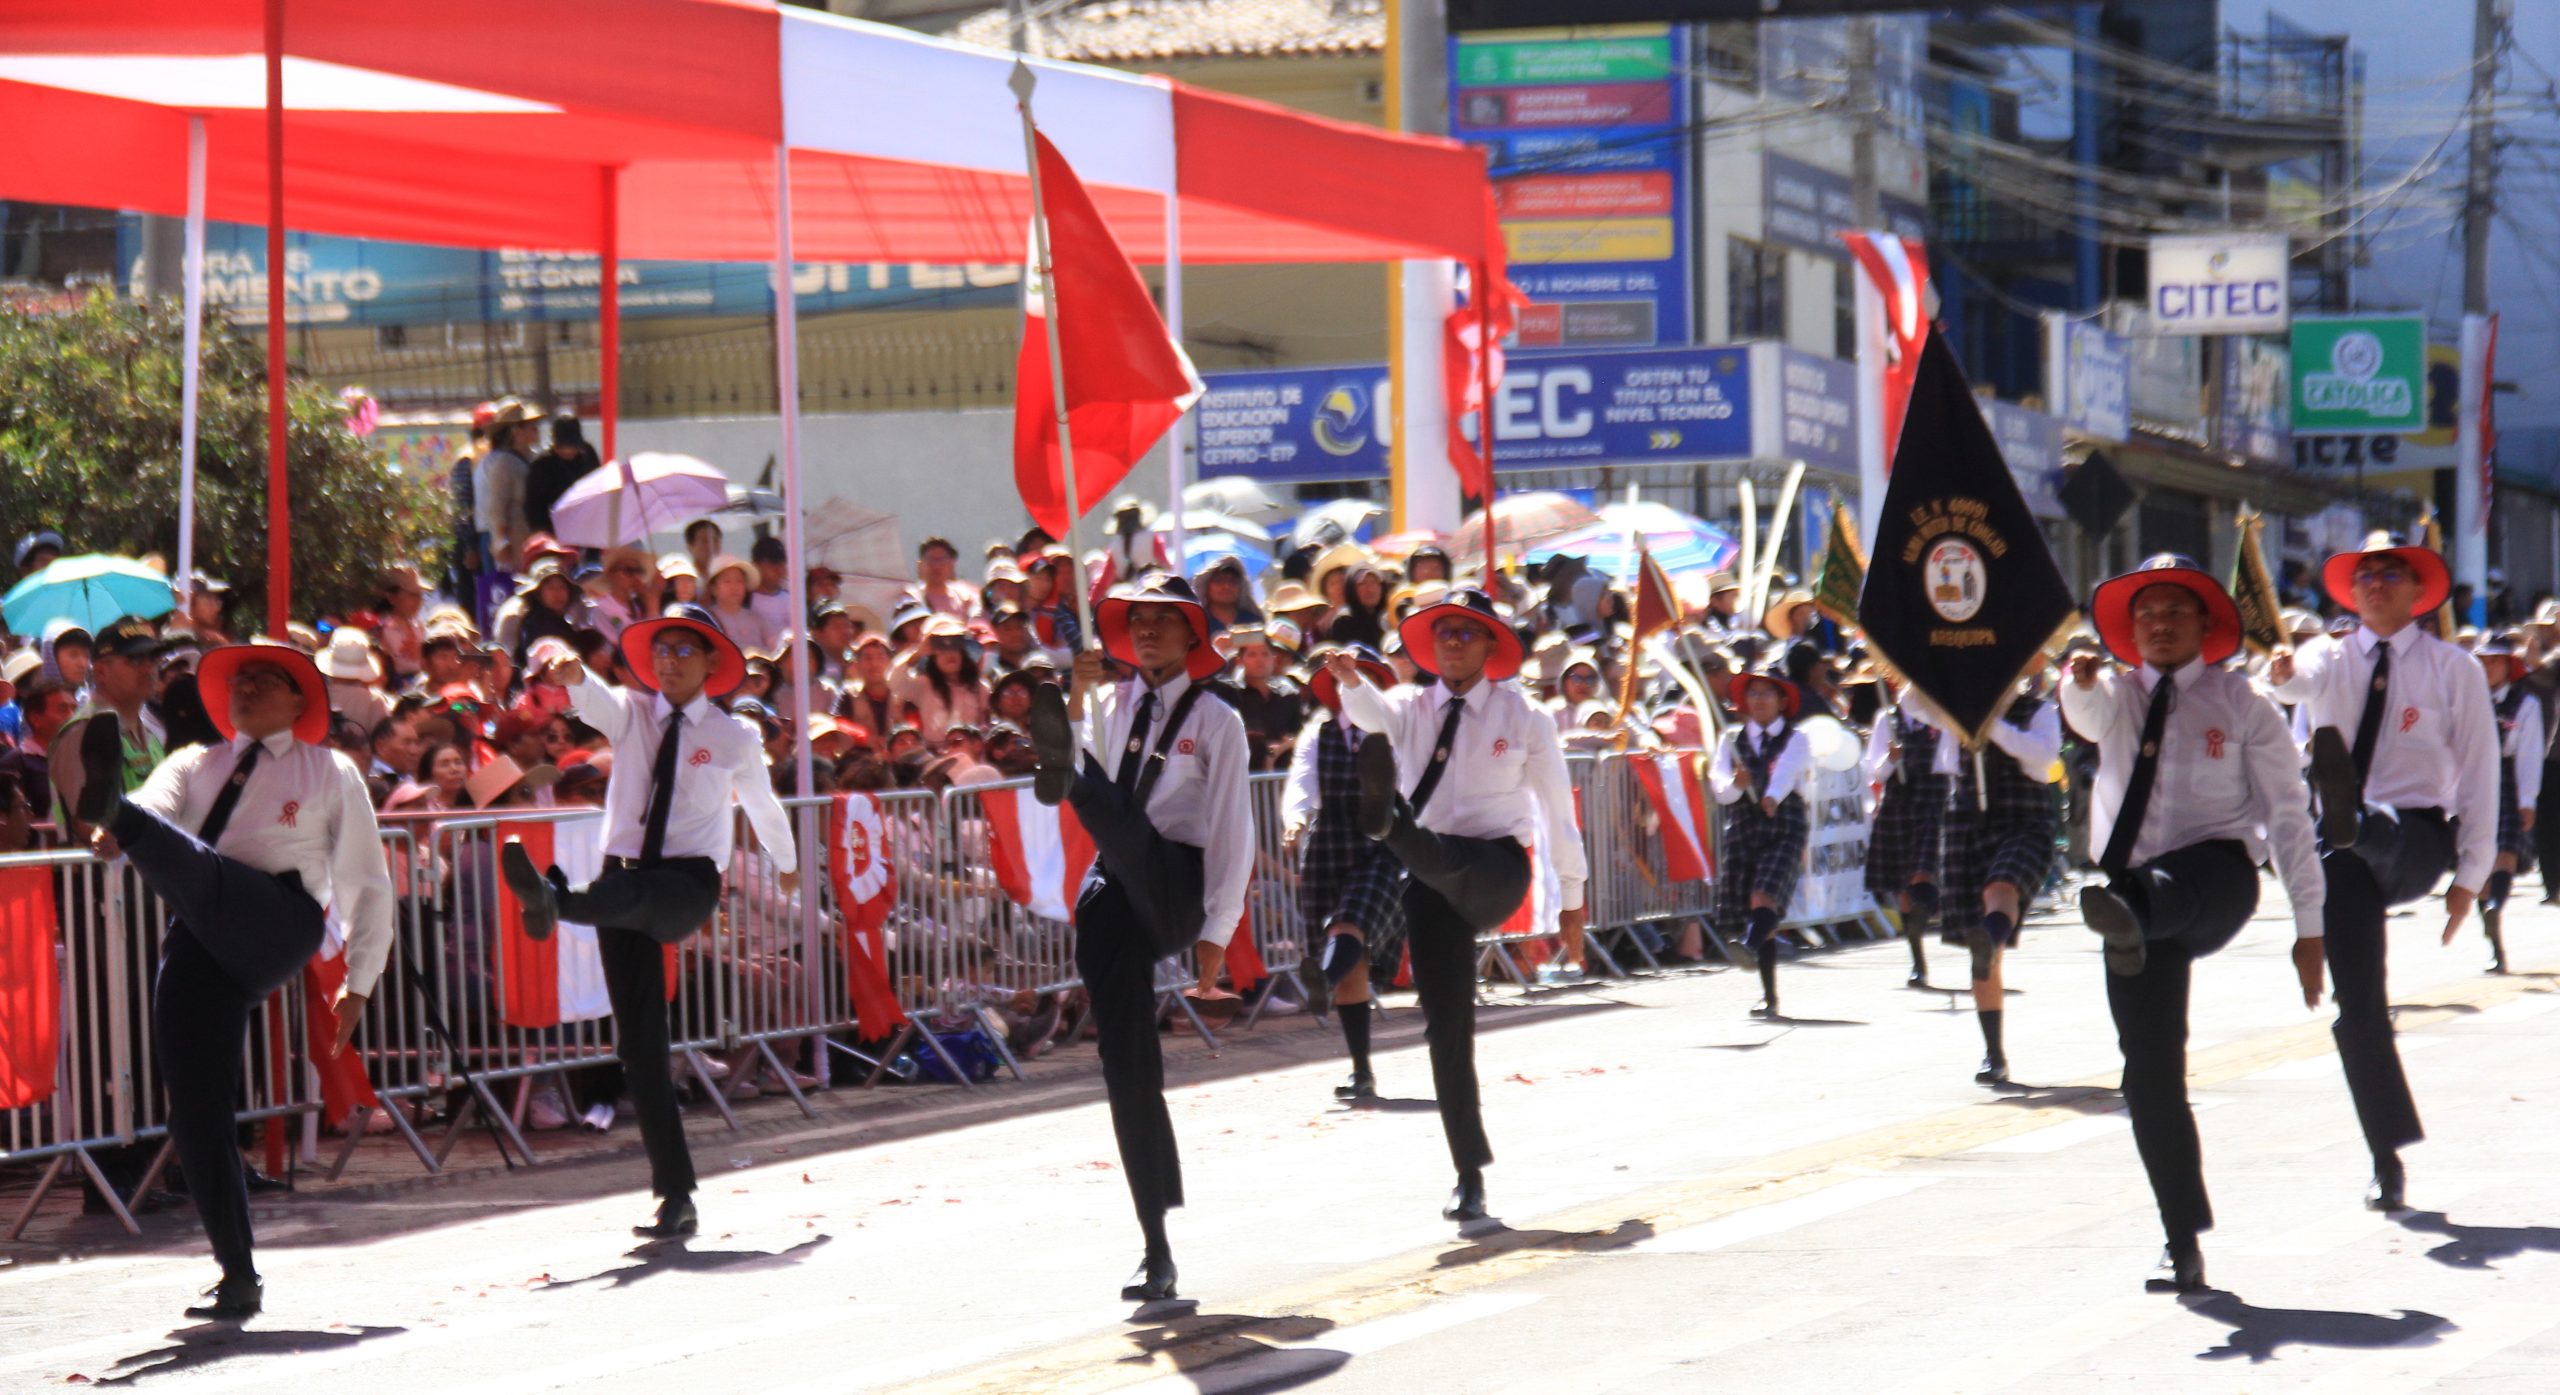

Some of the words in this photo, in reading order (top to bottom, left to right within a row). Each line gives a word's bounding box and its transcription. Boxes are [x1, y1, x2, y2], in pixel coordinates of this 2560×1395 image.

[1551, 274, 1621, 293] NOMBRE
[1626, 274, 1659, 292] DEL
[2158, 281, 2280, 319] CITEC
[1689, 367, 1711, 384] TU
[1202, 389, 1278, 409] INSTITUTO
[1282, 387, 1303, 405] DE
[1676, 385, 1700, 401] EN
[1703, 384, 1723, 401] EL
[1605, 405, 1656, 423] NIVEL
[1202, 428, 1274, 447] SUPERIOR
[1929, 628, 1998, 649] AREQUIPA
